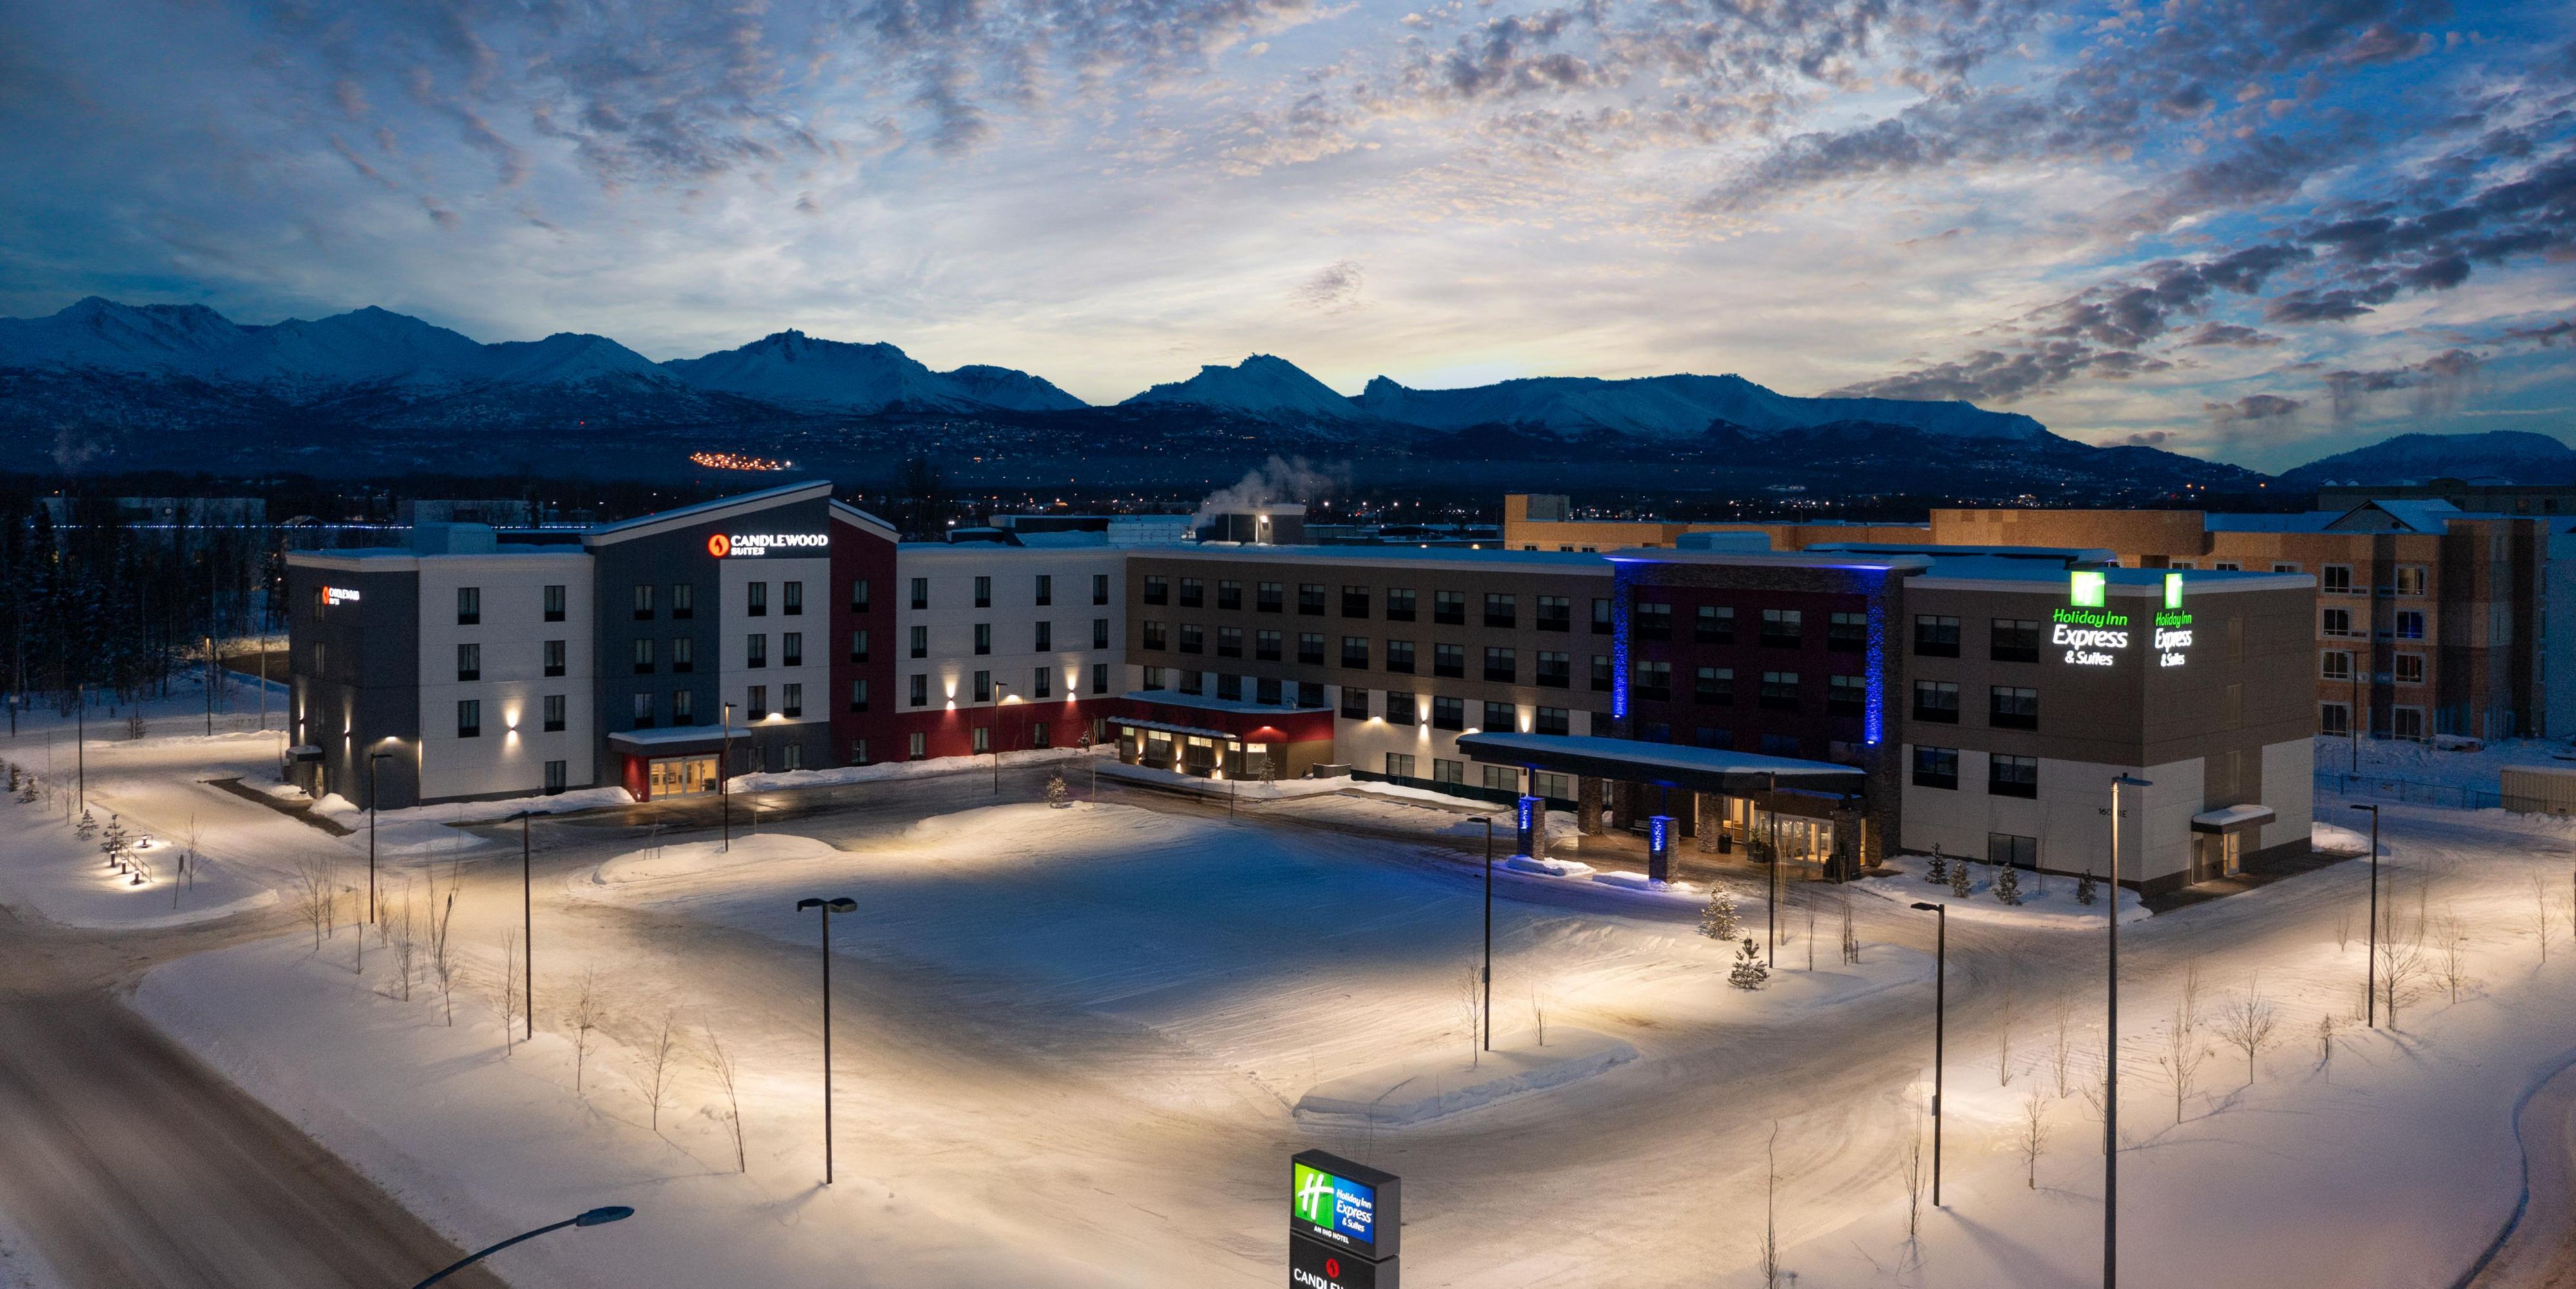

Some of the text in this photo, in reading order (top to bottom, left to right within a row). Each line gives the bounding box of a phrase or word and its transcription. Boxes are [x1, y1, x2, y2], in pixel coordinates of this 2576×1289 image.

[730, 534, 829, 547] CANDLEWOOD
[730, 546, 765, 556] SUITES
[2053, 609, 2128, 628] Holiday Inn
[2155, 610, 2192, 629] Holiday Inn
[2052, 624, 2128, 651] Express
[2155, 627, 2193, 653] Express
[2065, 650, 2114, 666] & Suites
[1336, 1189, 1372, 1209] Holiday Inn
[1336, 1199, 1372, 1223] Express
[1342, 1217, 1365, 1232] & Suites
[1314, 1225, 1350, 1244] AN IHG HOTEL
